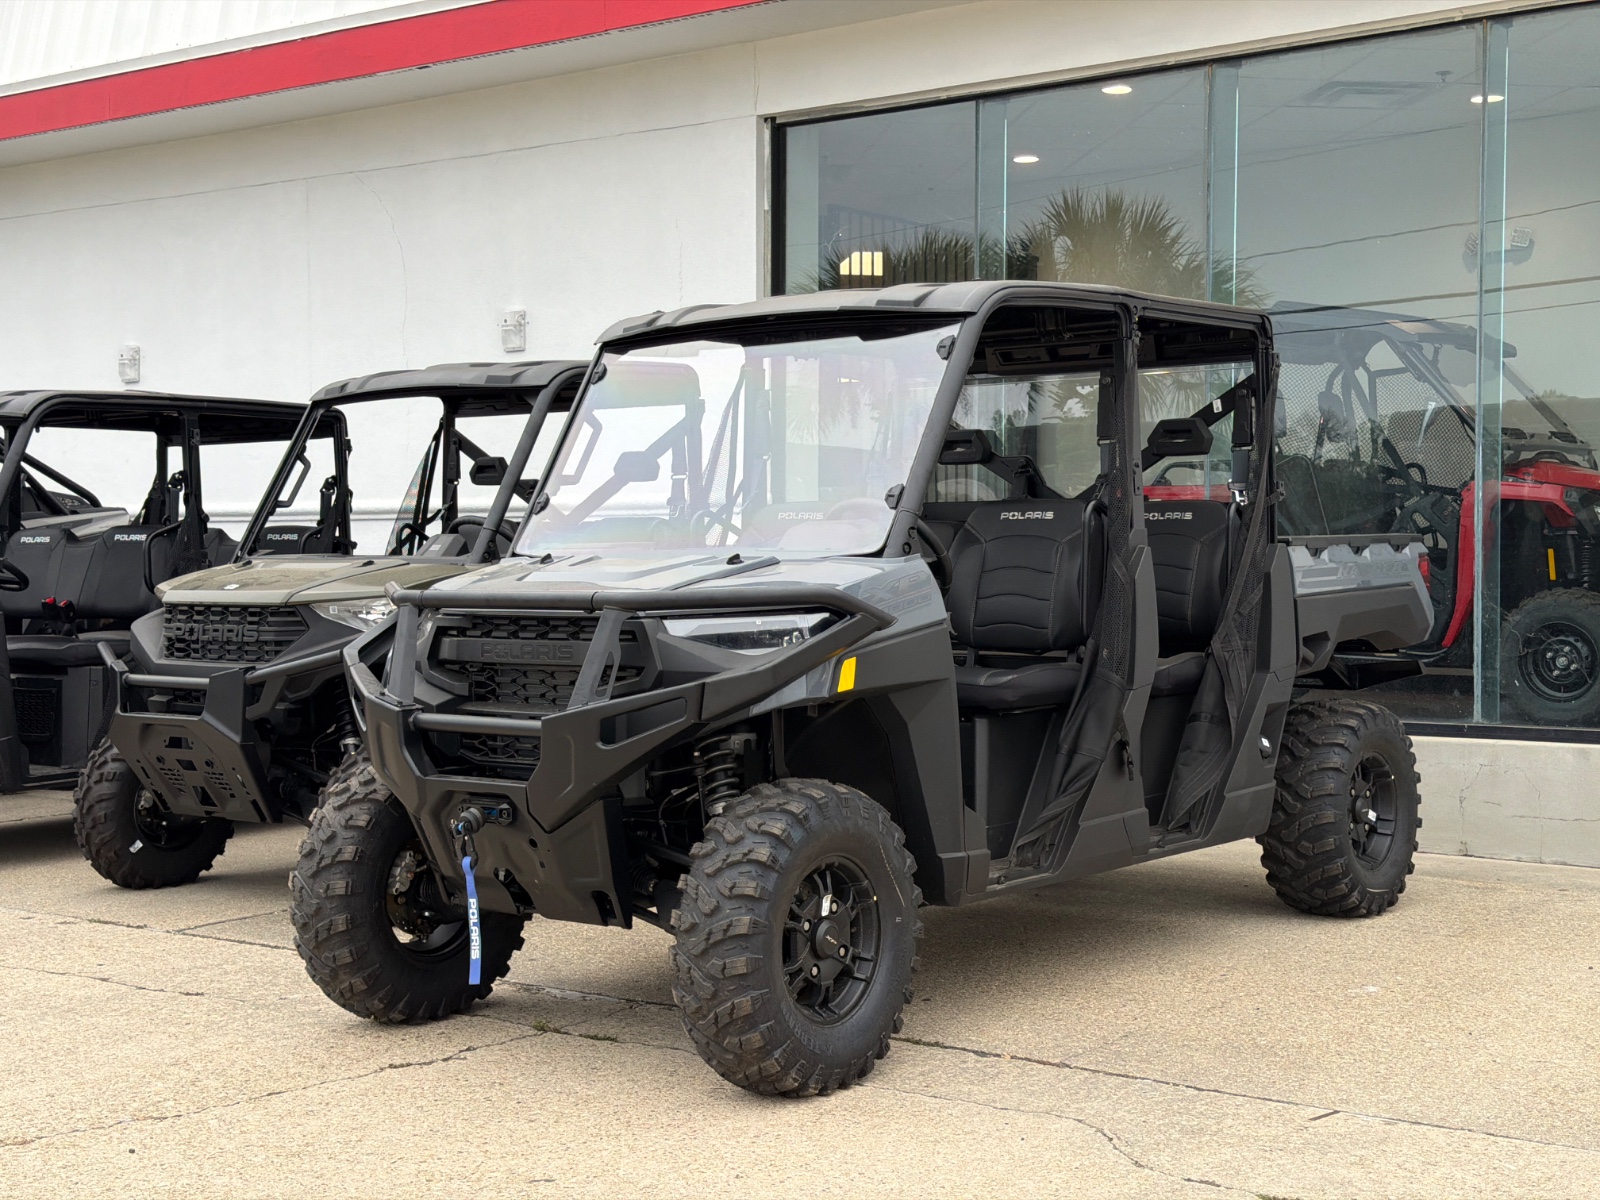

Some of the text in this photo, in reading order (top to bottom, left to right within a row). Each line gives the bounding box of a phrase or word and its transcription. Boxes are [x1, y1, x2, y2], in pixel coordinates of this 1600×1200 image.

[777, 511, 824, 520] POLARIS
[1000, 511, 1054, 520] POLARIS
[266, 533, 299, 541] POLARIS
[173, 623, 259, 642] POLARIS
[480, 642, 574, 662] POLARIS
[469, 898, 480, 960] POLARIS
